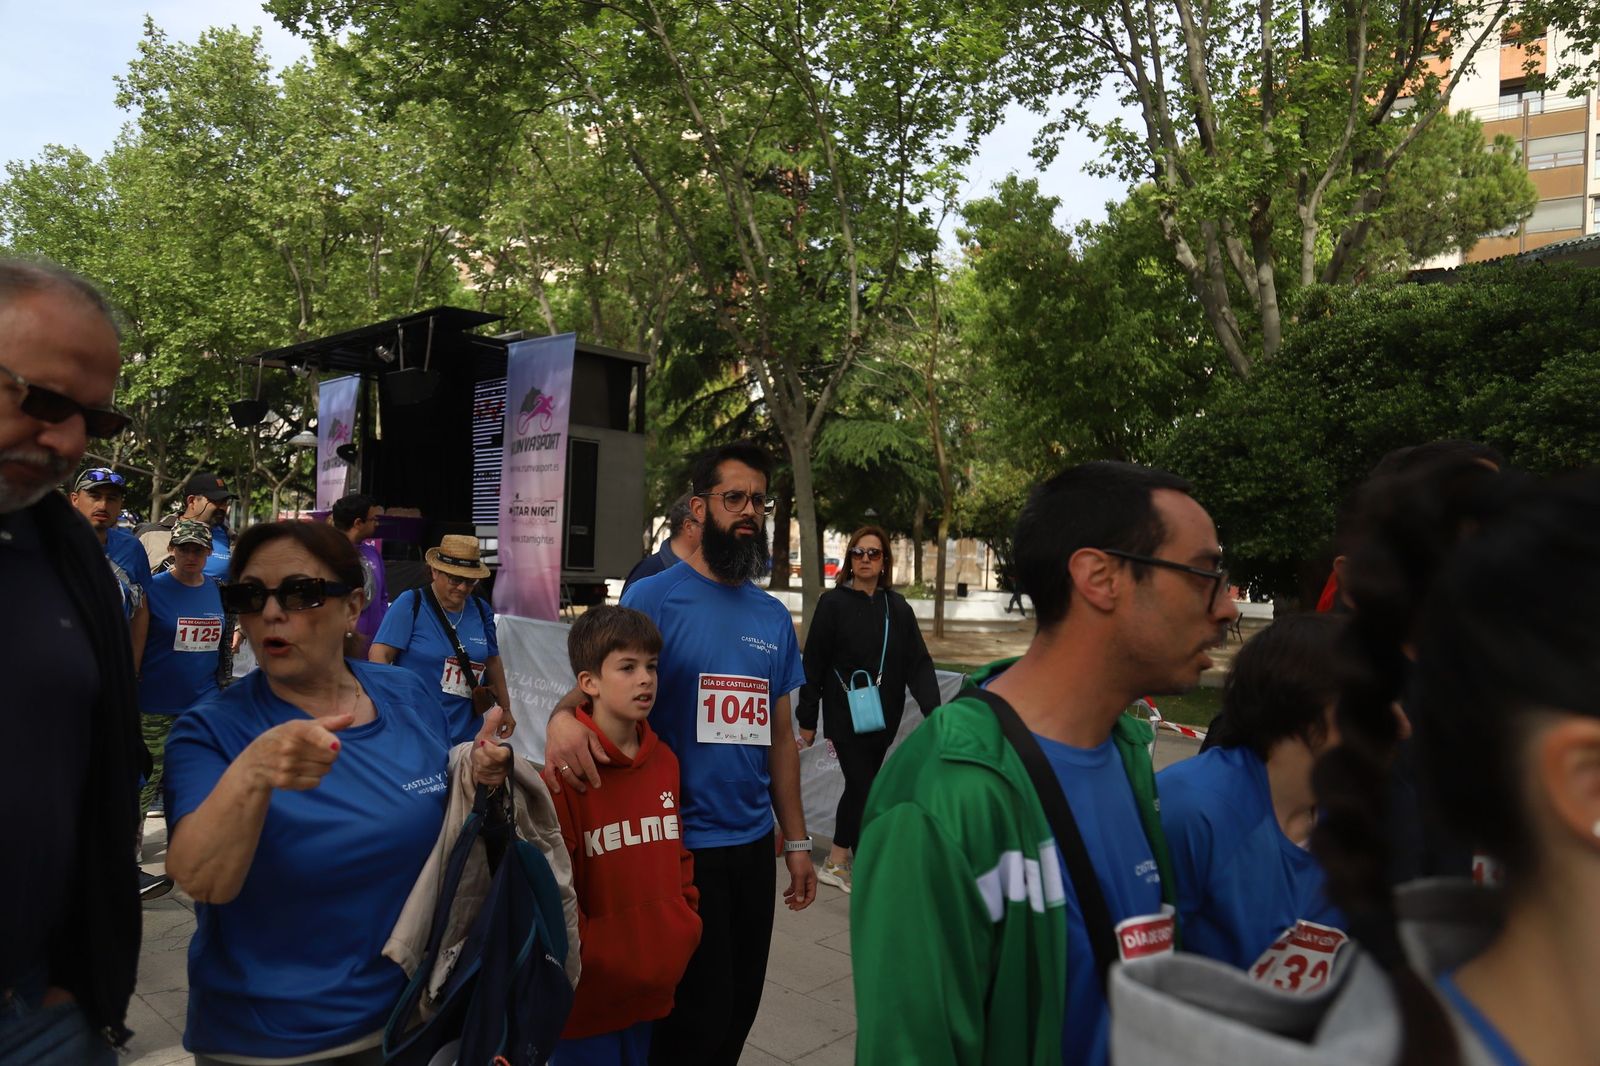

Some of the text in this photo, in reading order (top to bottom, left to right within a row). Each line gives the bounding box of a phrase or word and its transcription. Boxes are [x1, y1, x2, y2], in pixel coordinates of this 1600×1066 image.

[530, 506, 555, 517] NIGHT
[180, 627, 220, 642] 1125
[726, 680, 753, 689] CASTILLA
[703, 694, 768, 726] 1045
[402, 777, 435, 790] CASTILLA
[435, 773, 442, 782] Y
[584, 815, 679, 857] KELME
[1123, 929, 1148, 949] DÍA
